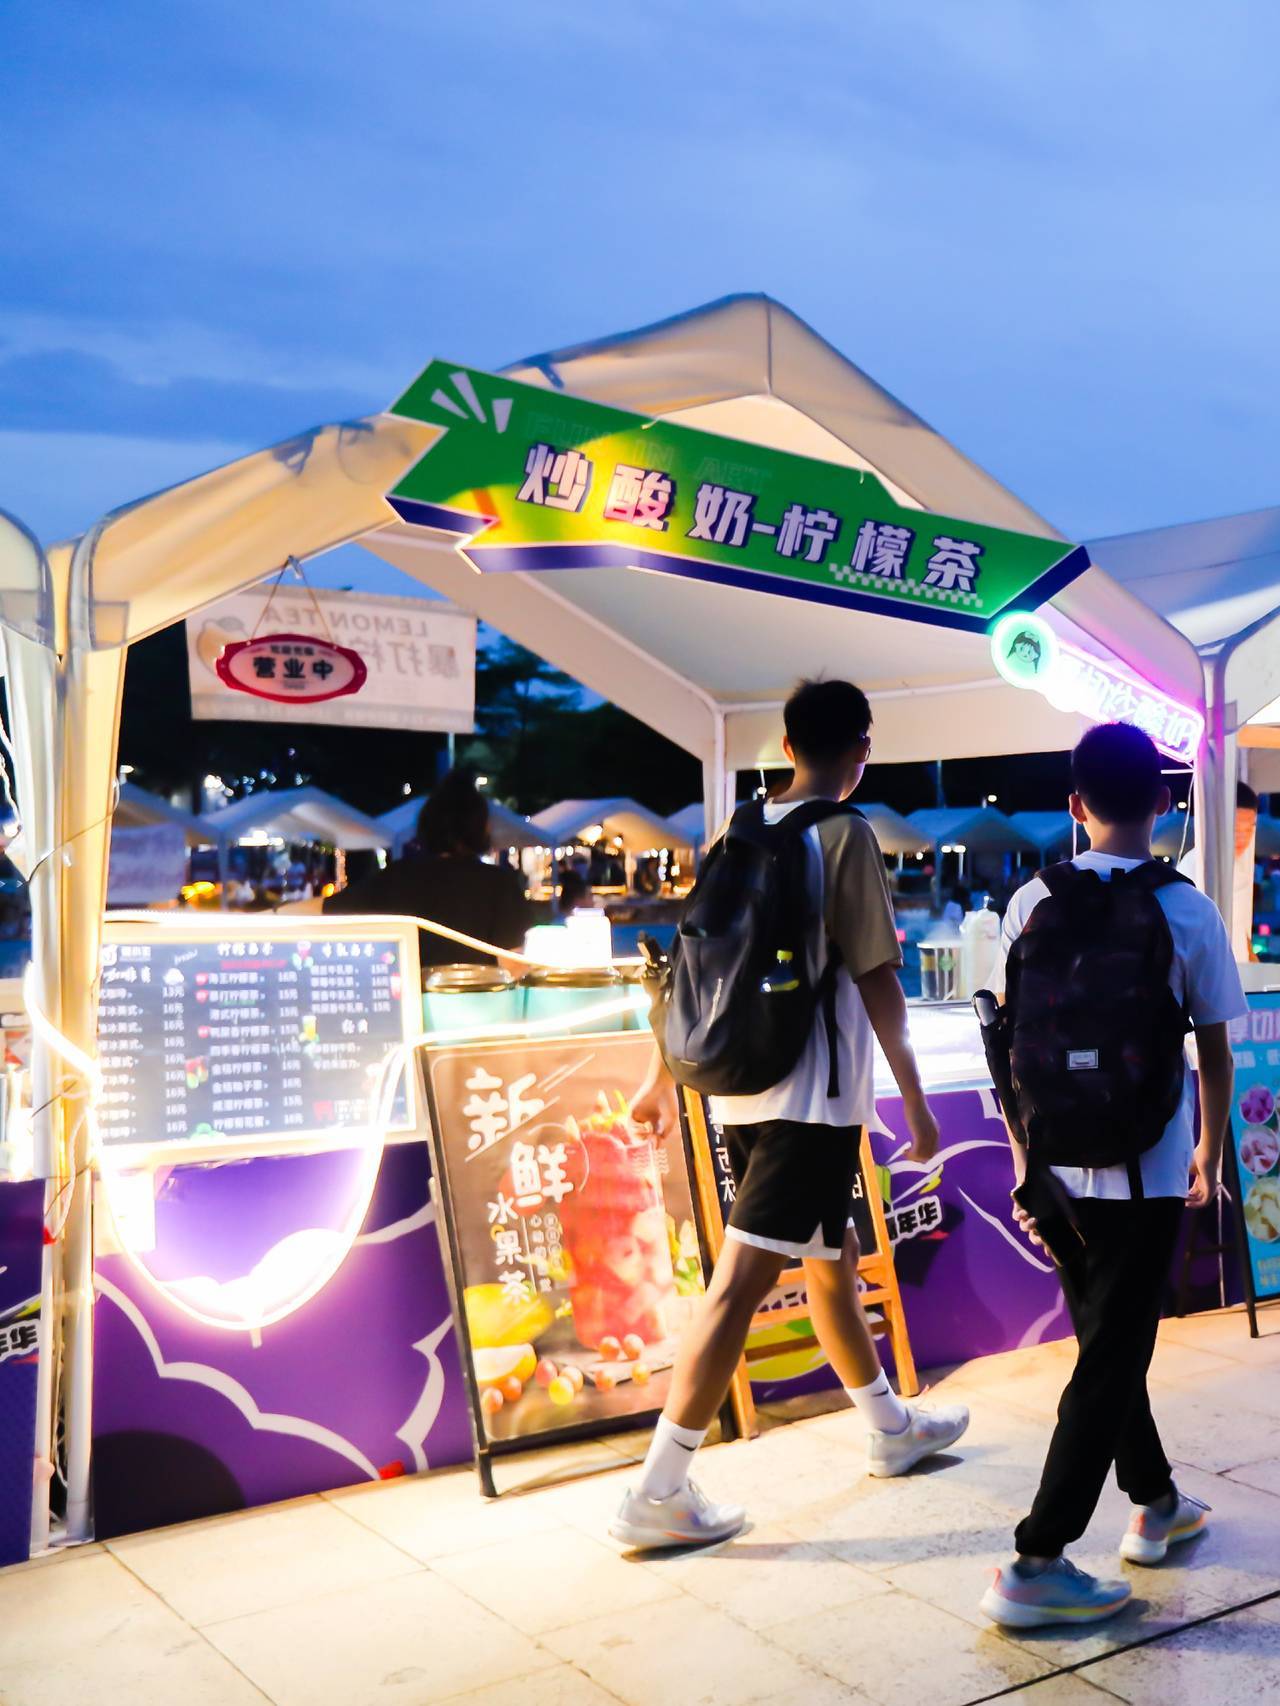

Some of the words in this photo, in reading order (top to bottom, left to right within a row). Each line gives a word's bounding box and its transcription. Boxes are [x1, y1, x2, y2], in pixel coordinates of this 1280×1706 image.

[516, 443, 985, 593] 炒酸奶-柠檬茶
[253, 656, 334, 681] 营业中
[486, 1191, 531, 1305] 水果茶
